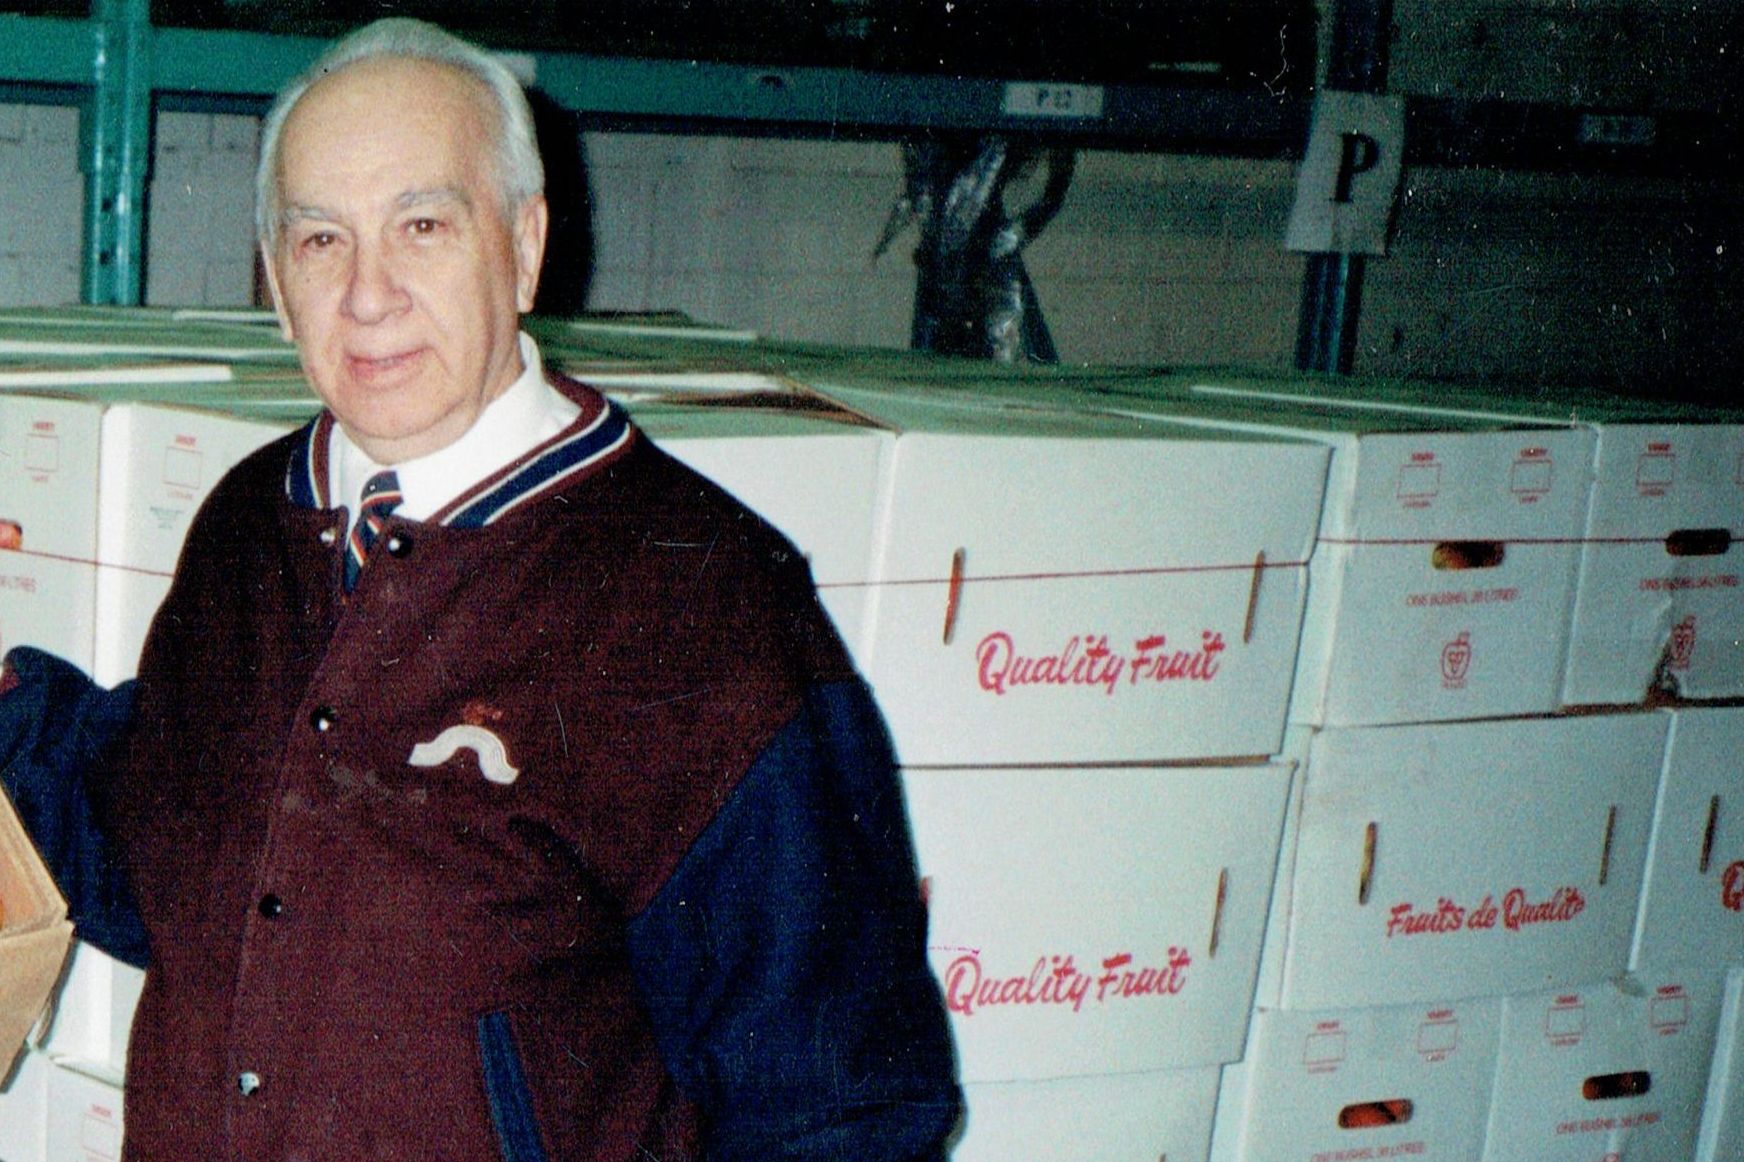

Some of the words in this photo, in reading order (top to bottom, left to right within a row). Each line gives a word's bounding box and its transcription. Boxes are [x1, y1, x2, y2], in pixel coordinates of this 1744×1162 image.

[1329, 132, 1379, 202] P
[975, 631, 1125, 694] Quality
[1129, 629, 1225, 685] Fruit
[1387, 898, 1465, 937] Fruits
[1467, 896, 1498, 930] de
[944, 955, 1092, 1016] Quality
[1096, 946, 1192, 1002] Fruit
